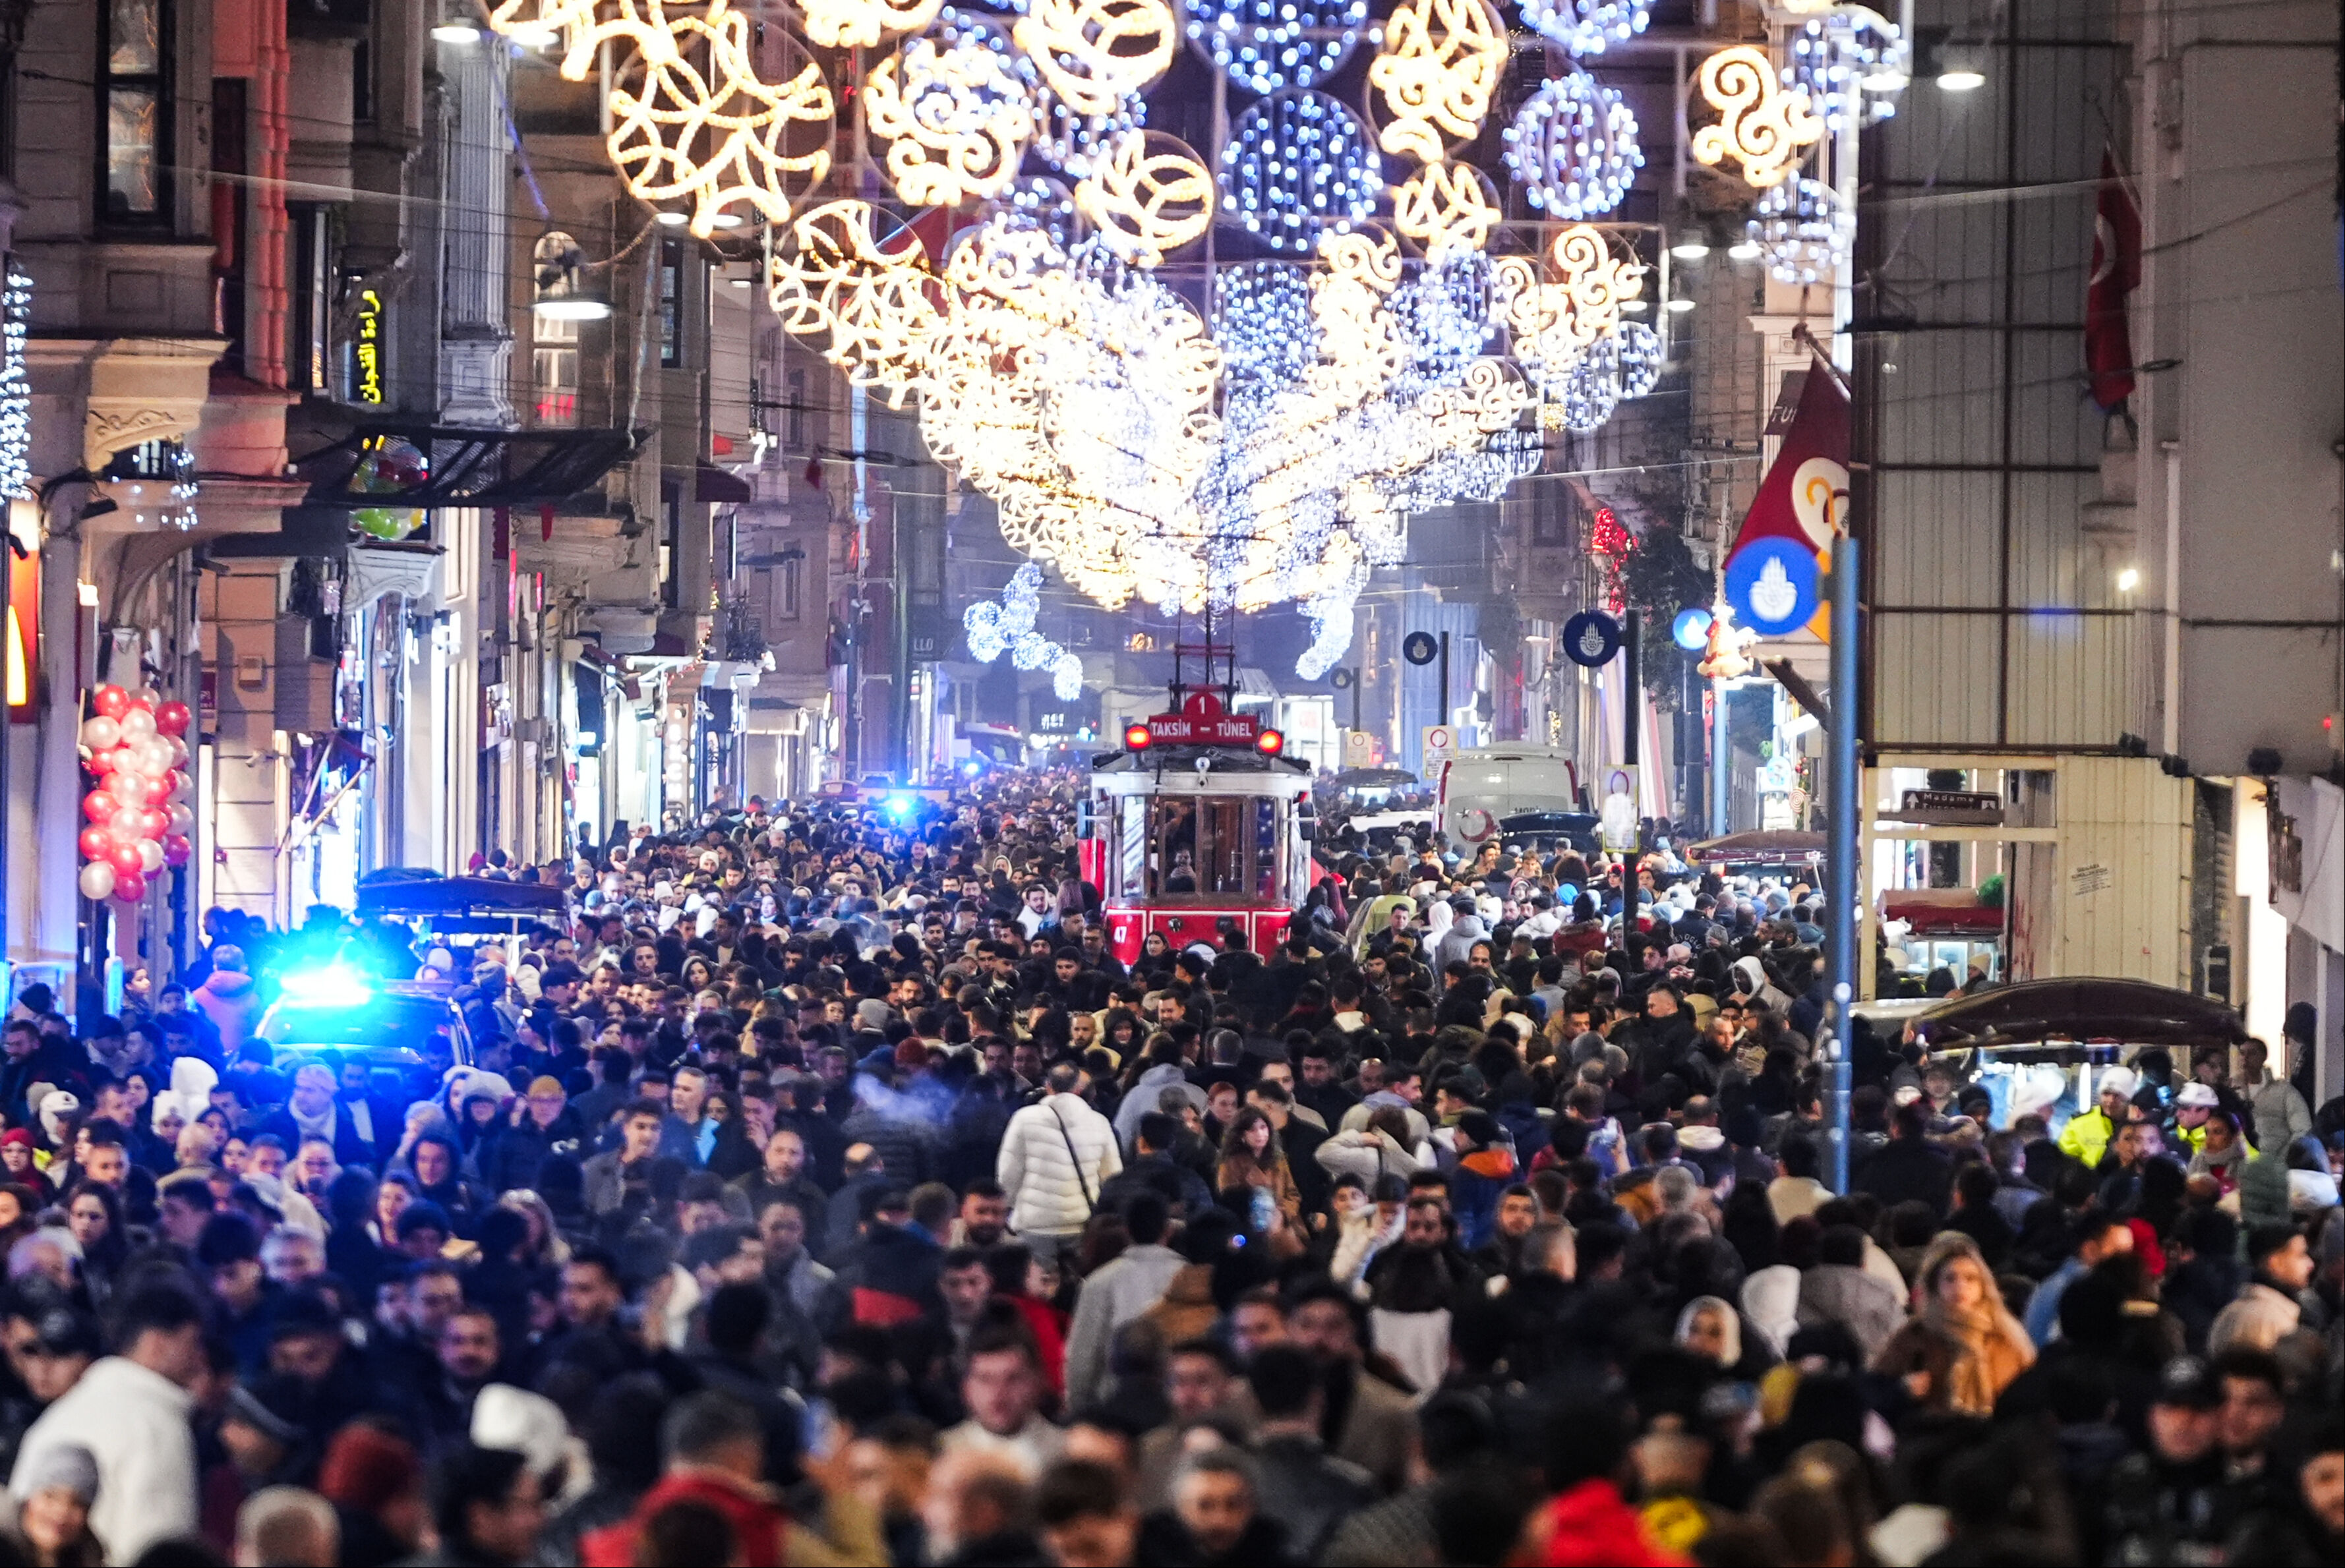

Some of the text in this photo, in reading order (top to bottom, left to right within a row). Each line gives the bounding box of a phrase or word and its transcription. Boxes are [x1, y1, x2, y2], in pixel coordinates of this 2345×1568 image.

[1199, 696, 1205, 714] 1
[1151, 718, 1191, 736] TAKSİM
[1216, 719, 1252, 737] TÜNEL
[1924, 793, 1974, 801] Madame
[1113, 925, 1127, 943] 47
